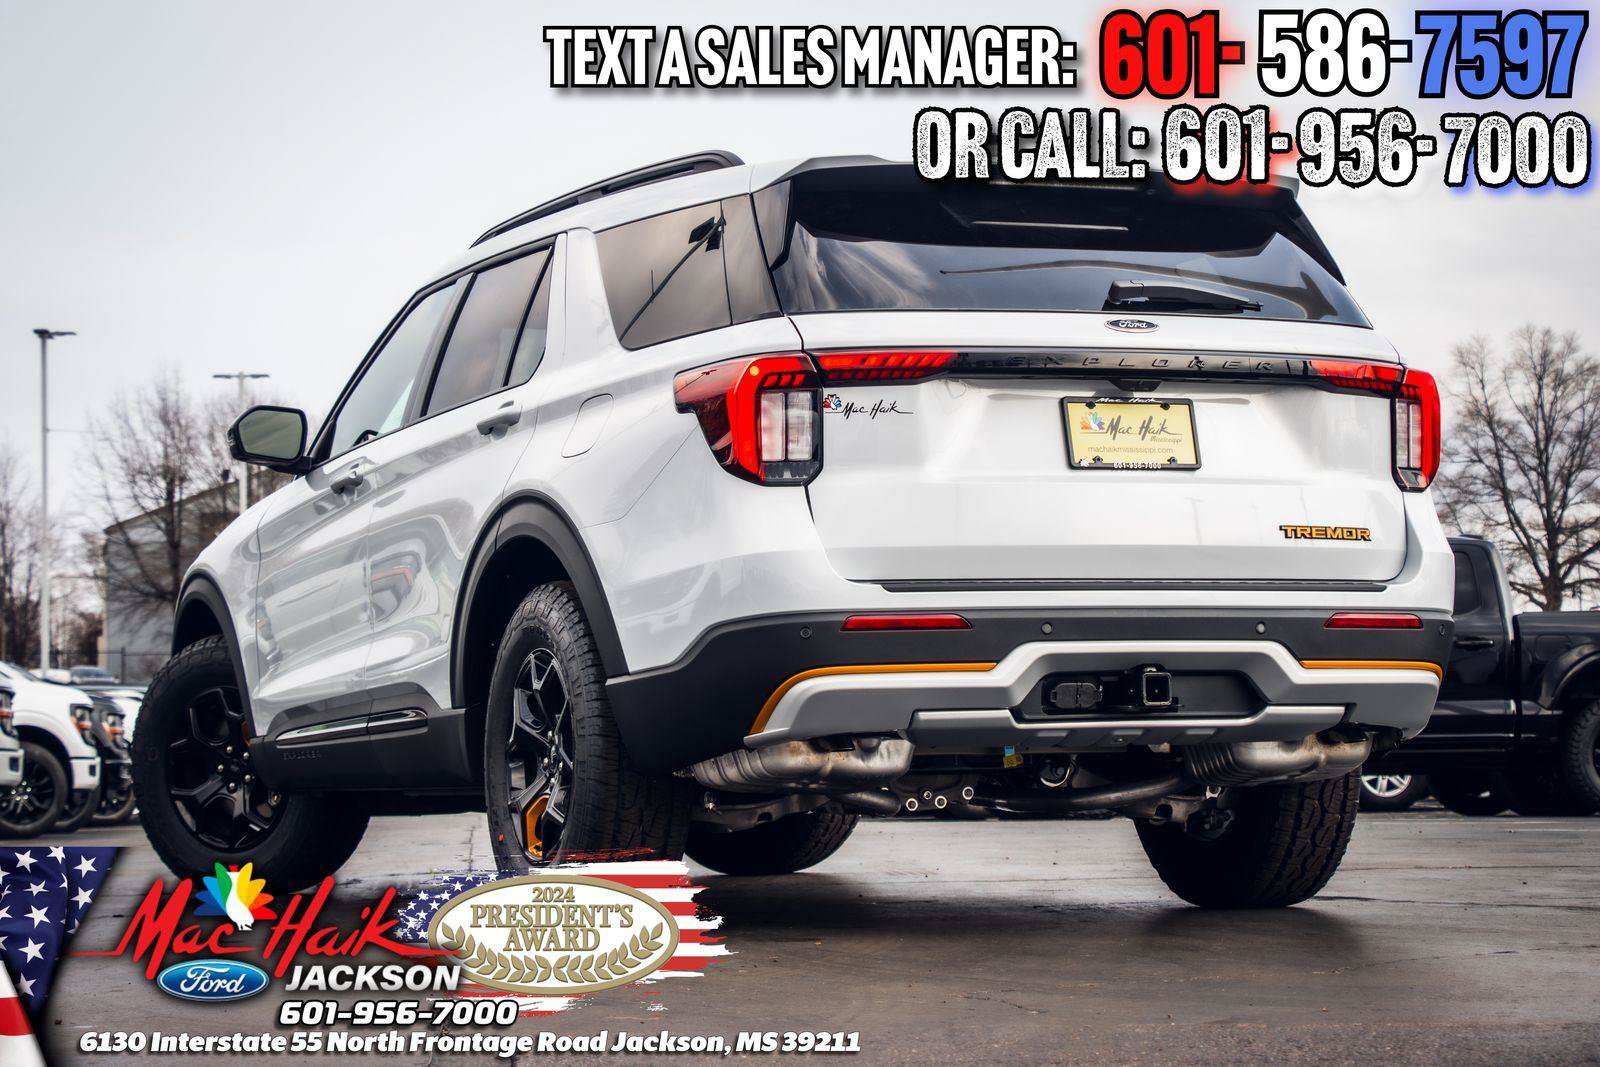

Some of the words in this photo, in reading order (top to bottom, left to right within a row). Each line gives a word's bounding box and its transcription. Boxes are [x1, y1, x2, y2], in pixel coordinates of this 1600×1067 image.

[1118, 319, 1148, 329] Ford
[1006, 356, 1274, 371] EXPLORER
[840, 402, 868, 420] Mac
[869, 399, 908, 420] Haik
[1106, 415, 1134, 440] Mac
[1138, 415, 1176, 440] Haik
[1280, 525, 1371, 541] TREMOR
